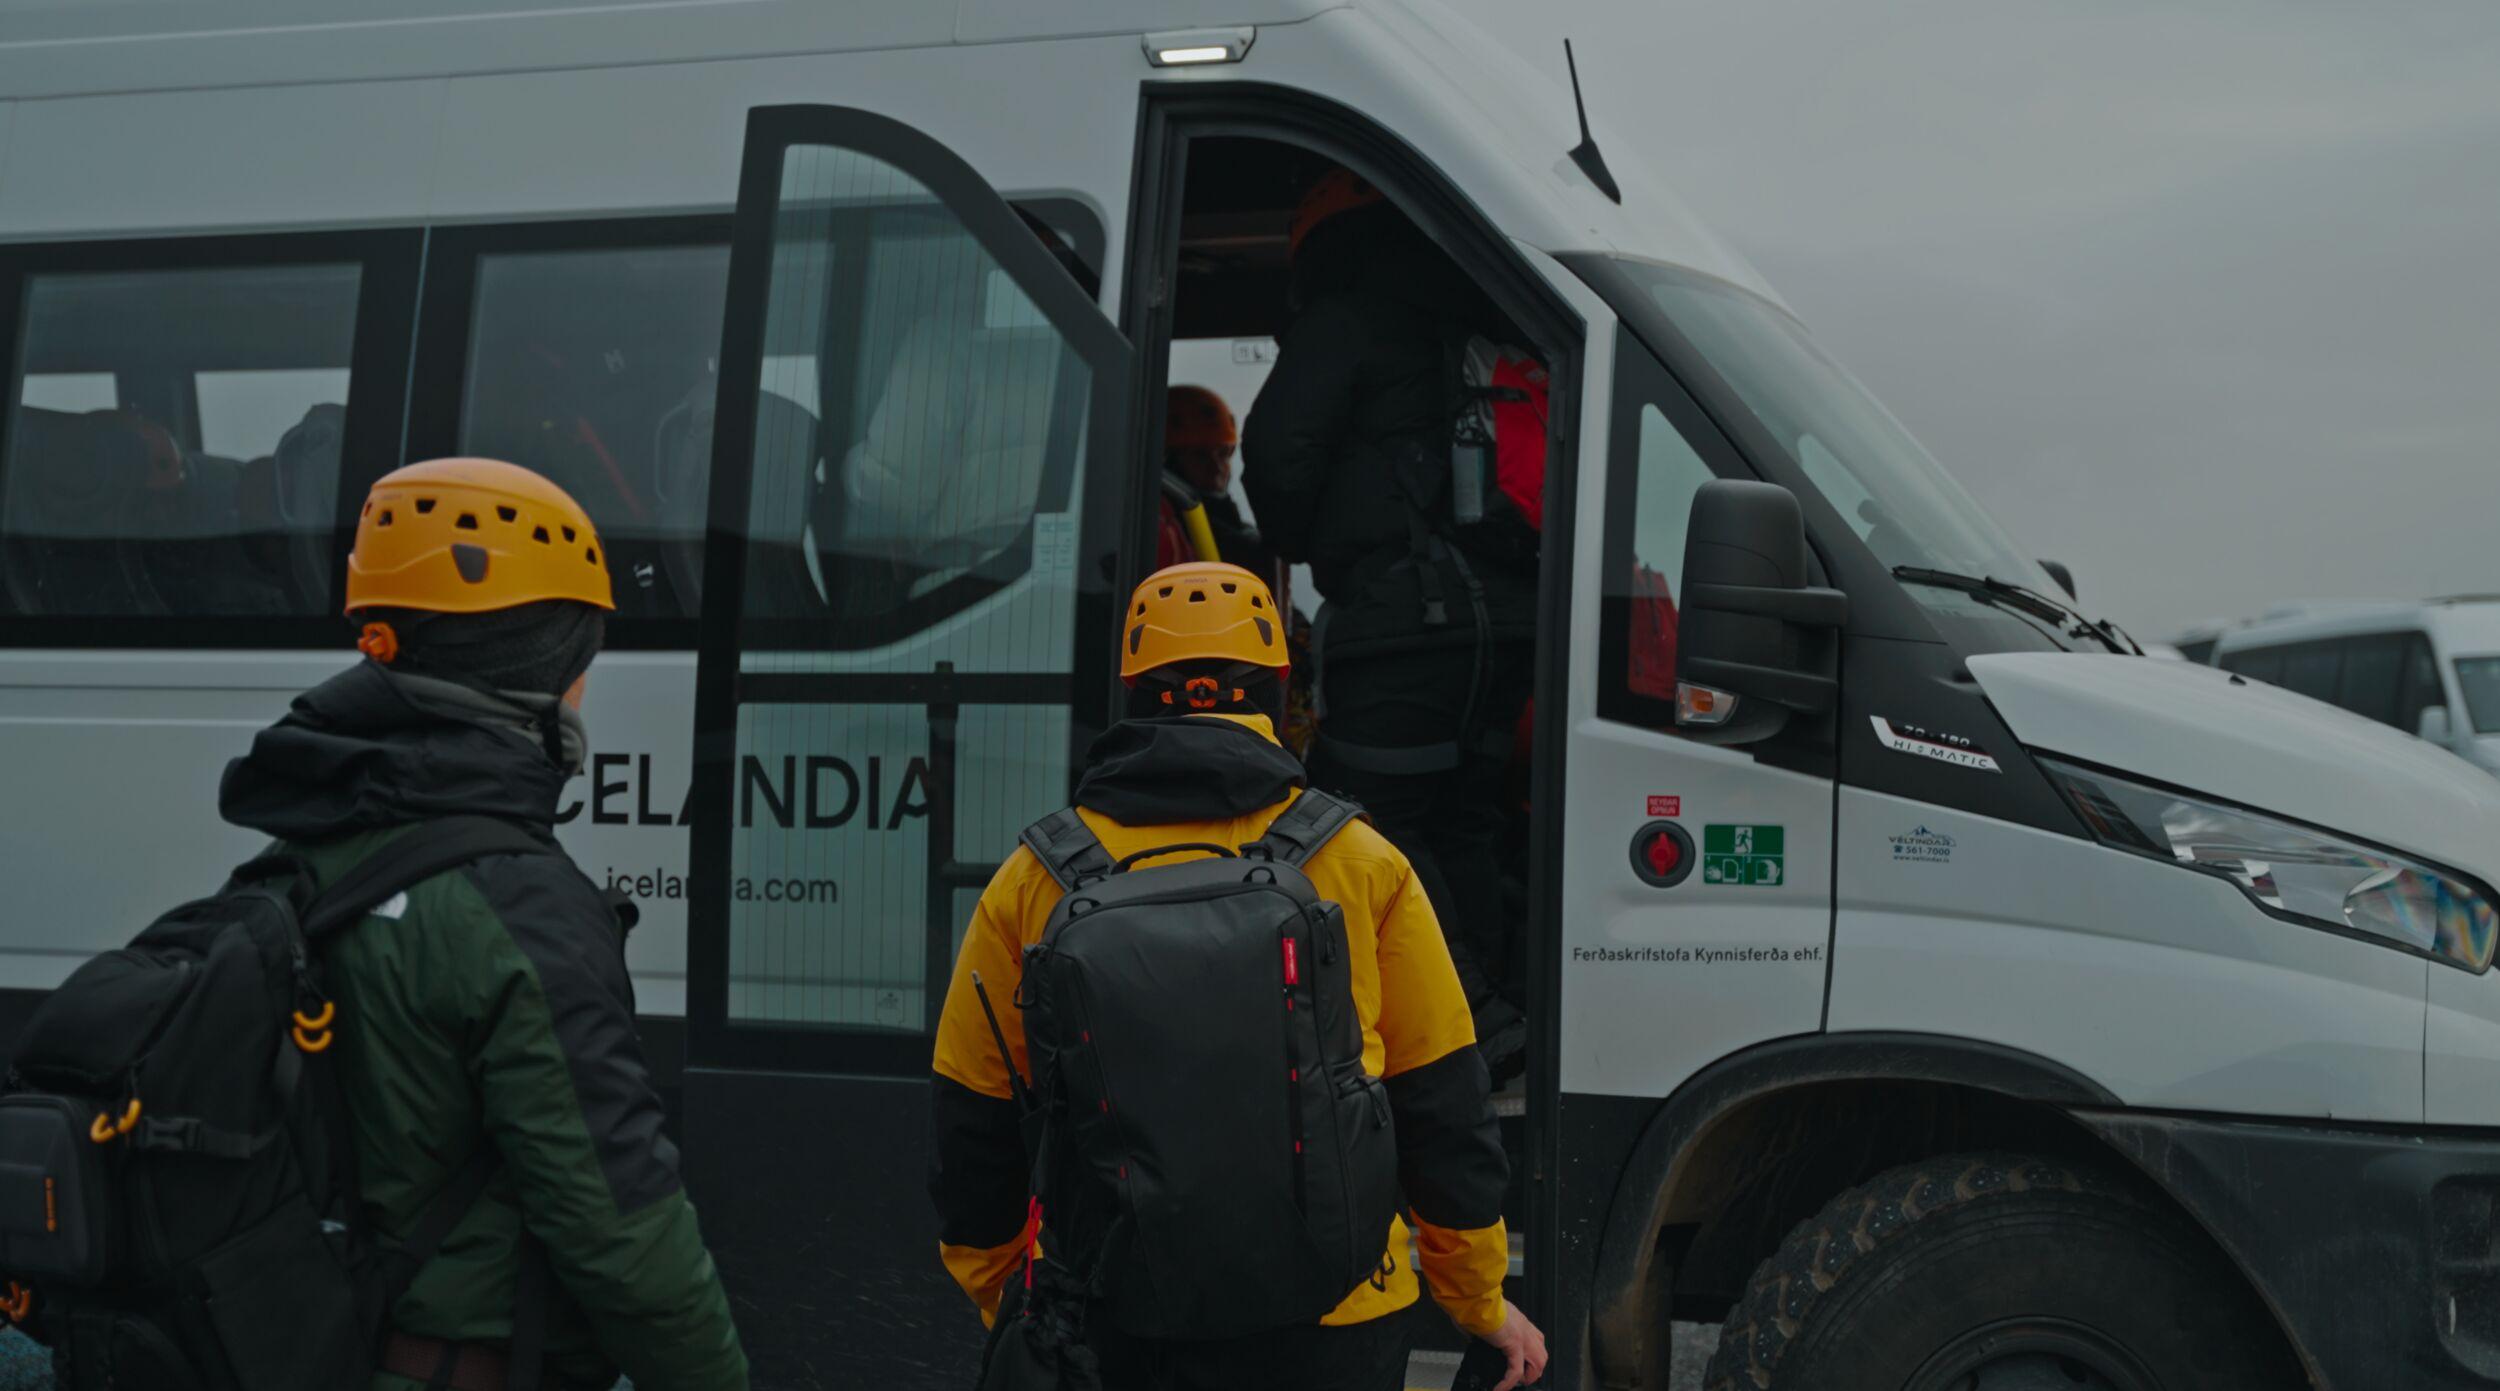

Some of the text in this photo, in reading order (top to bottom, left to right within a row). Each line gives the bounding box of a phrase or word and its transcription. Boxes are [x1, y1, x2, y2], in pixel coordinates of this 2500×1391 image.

[607, 867, 838, 902] icelaa.com
[1574, 947, 1822, 964] Ferðaskrifstofa Kynnisferða ehf.
